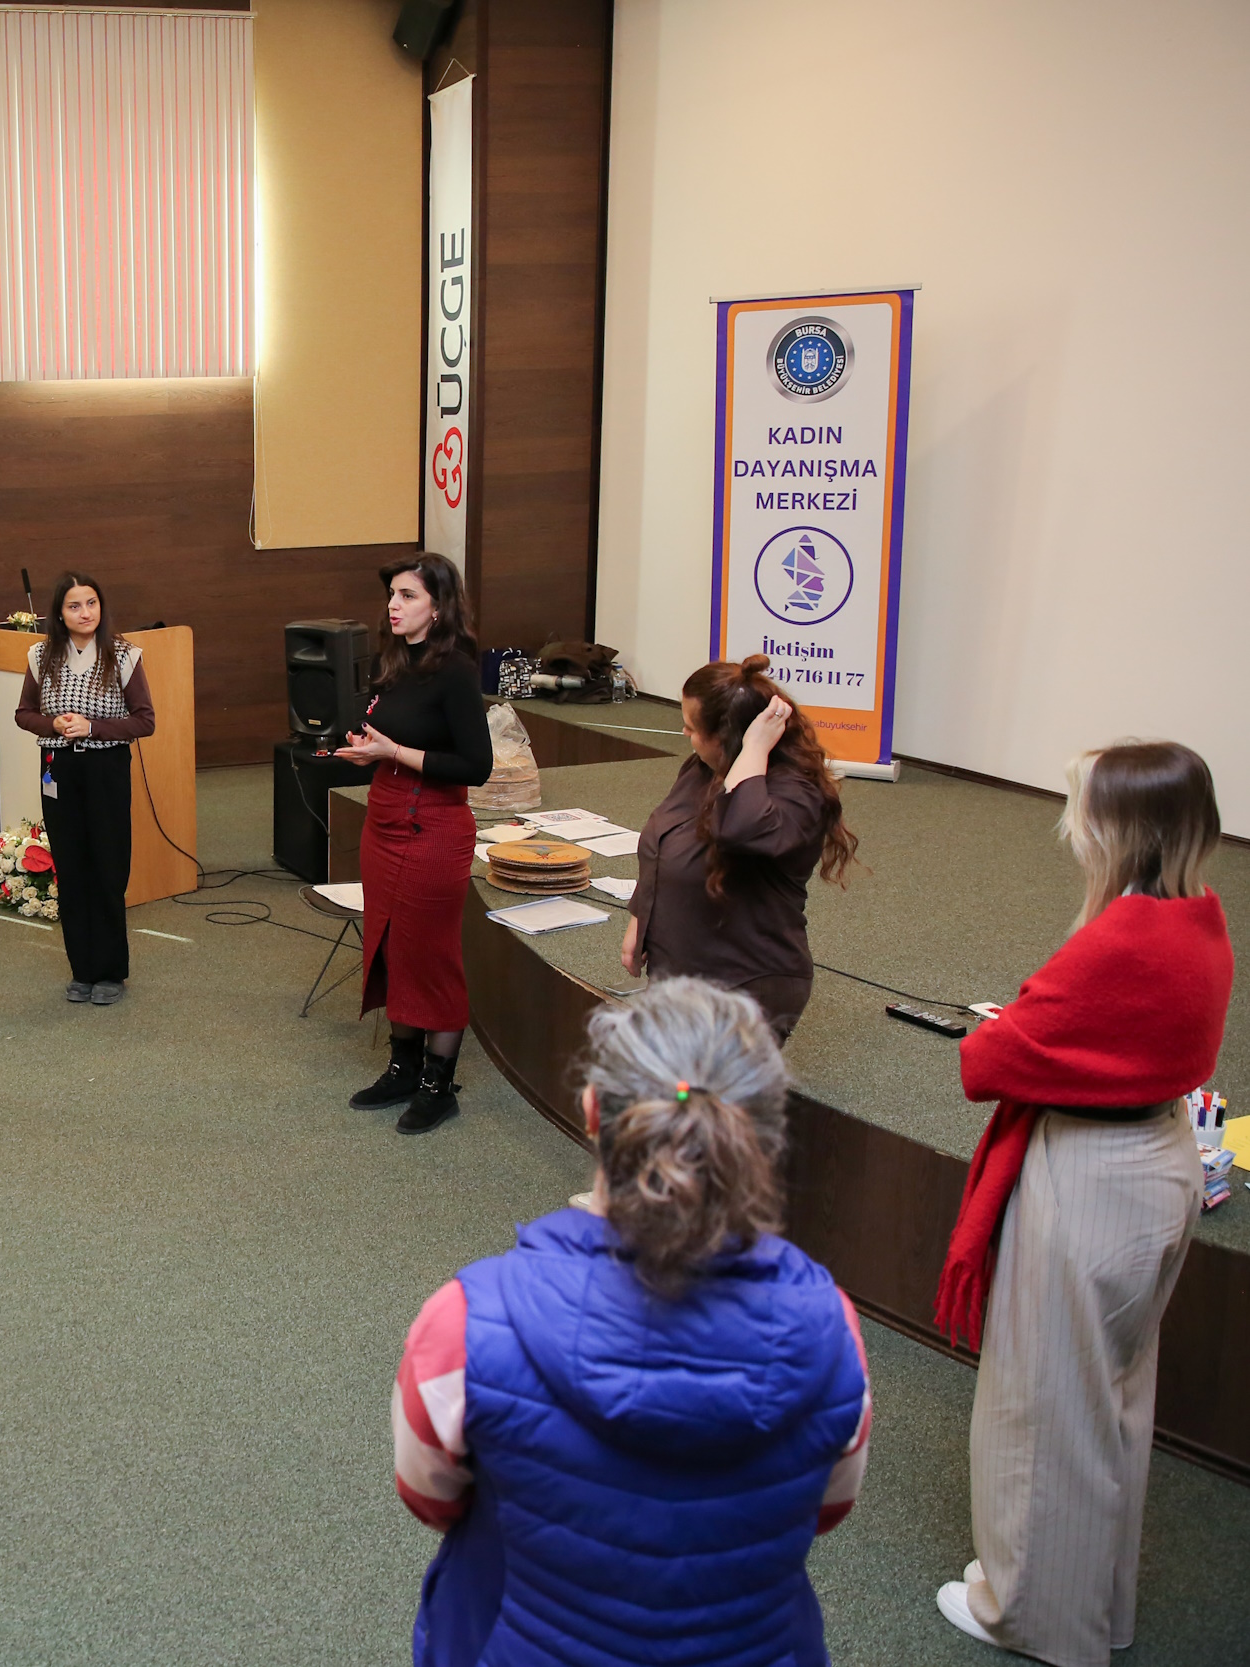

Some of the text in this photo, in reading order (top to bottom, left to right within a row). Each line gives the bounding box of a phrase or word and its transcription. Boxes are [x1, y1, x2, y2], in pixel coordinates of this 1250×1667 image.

[795, 325, 827, 338] BURSA
[776, 355, 844, 395] BÜYÜKŞEHİR BELEDİYESİ
[768, 426, 842, 445] KADIN
[734, 459, 878, 483] DAYANIŞMA
[756, 488, 857, 511] MERKEZİ
[762, 635, 834, 662] İletişim
[795, 669, 823, 684] 716
[827, 671, 841, 685] 11
[845, 672, 865, 687] 77
